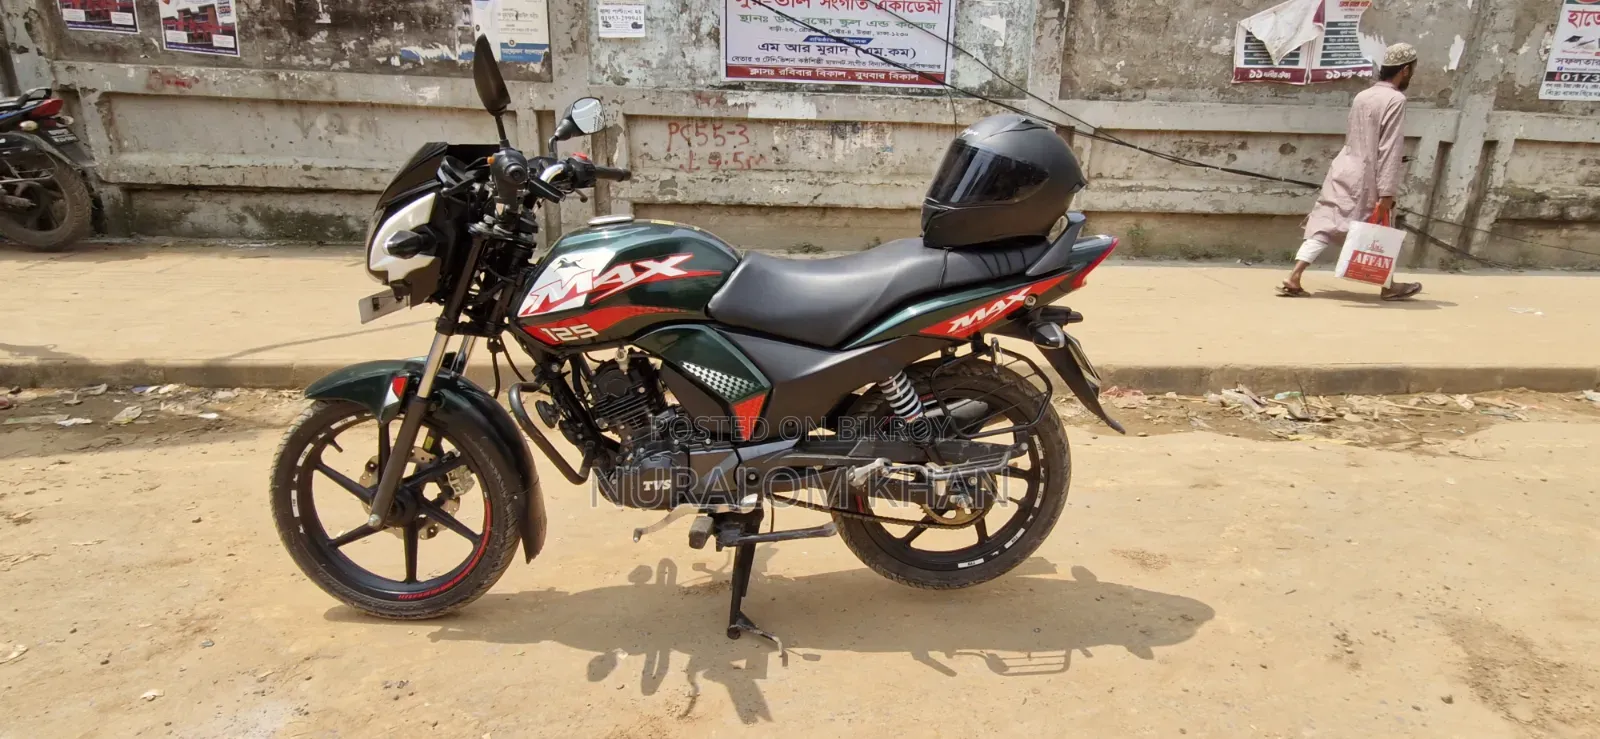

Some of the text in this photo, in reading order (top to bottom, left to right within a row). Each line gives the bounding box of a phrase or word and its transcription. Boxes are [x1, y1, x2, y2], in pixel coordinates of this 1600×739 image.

[758, 42, 780, 52] এম
[784, 43, 811, 53] আর
[817, 45, 850, 56] মুরাদ
[1353, 252, 1392, 269] AFFAN
[525, 252, 695, 315] MAX
[947, 286, 1032, 334] MAX
[540, 323, 599, 342] 125
[642, 479, 672, 492] TVS
